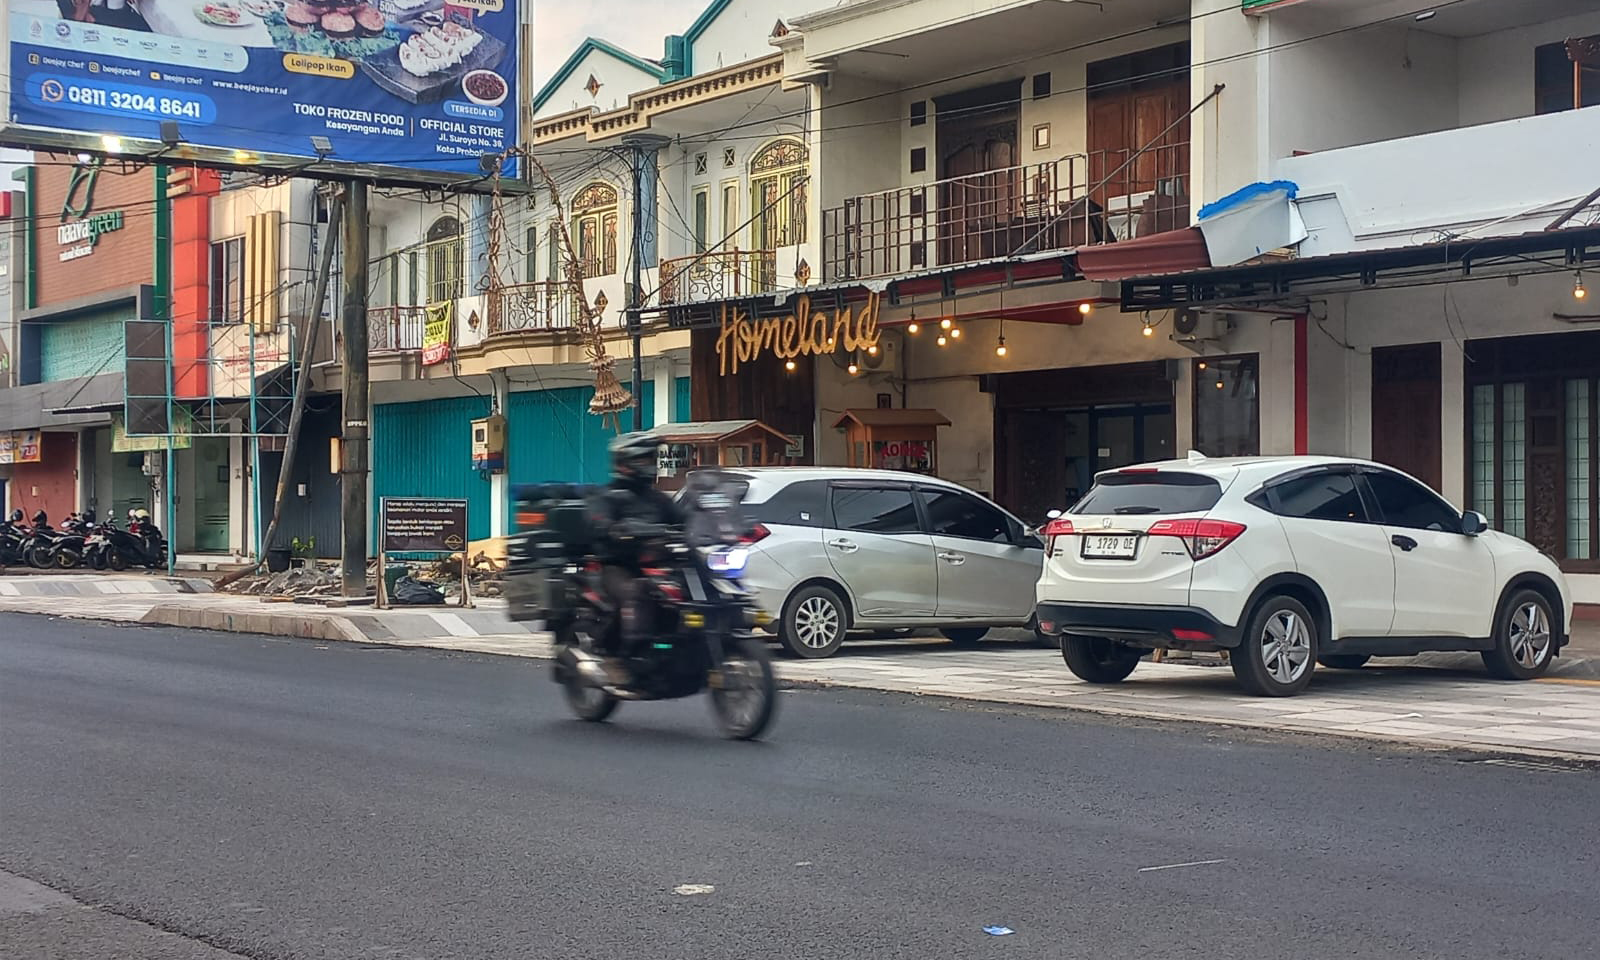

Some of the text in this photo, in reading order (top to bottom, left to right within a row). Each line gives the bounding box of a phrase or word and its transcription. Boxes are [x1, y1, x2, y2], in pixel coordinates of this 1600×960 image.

[326, 63, 347, 73] Ikan
[68, 86, 200, 118] 0811 3204 8641
[293, 102, 404, 127] TOKO FROZEN FOOD
[450, 103, 497, 118] TERSEDIA DI
[326, 119, 404, 137] Kesayangan Anda
[420, 118, 504, 139] OFFICIAL STORE
[436, 143, 455, 154] Kota
[478, 138, 491, 148] No.
[716, 291, 882, 377] Homeland
[1096, 537, 1119, 549] 1729
